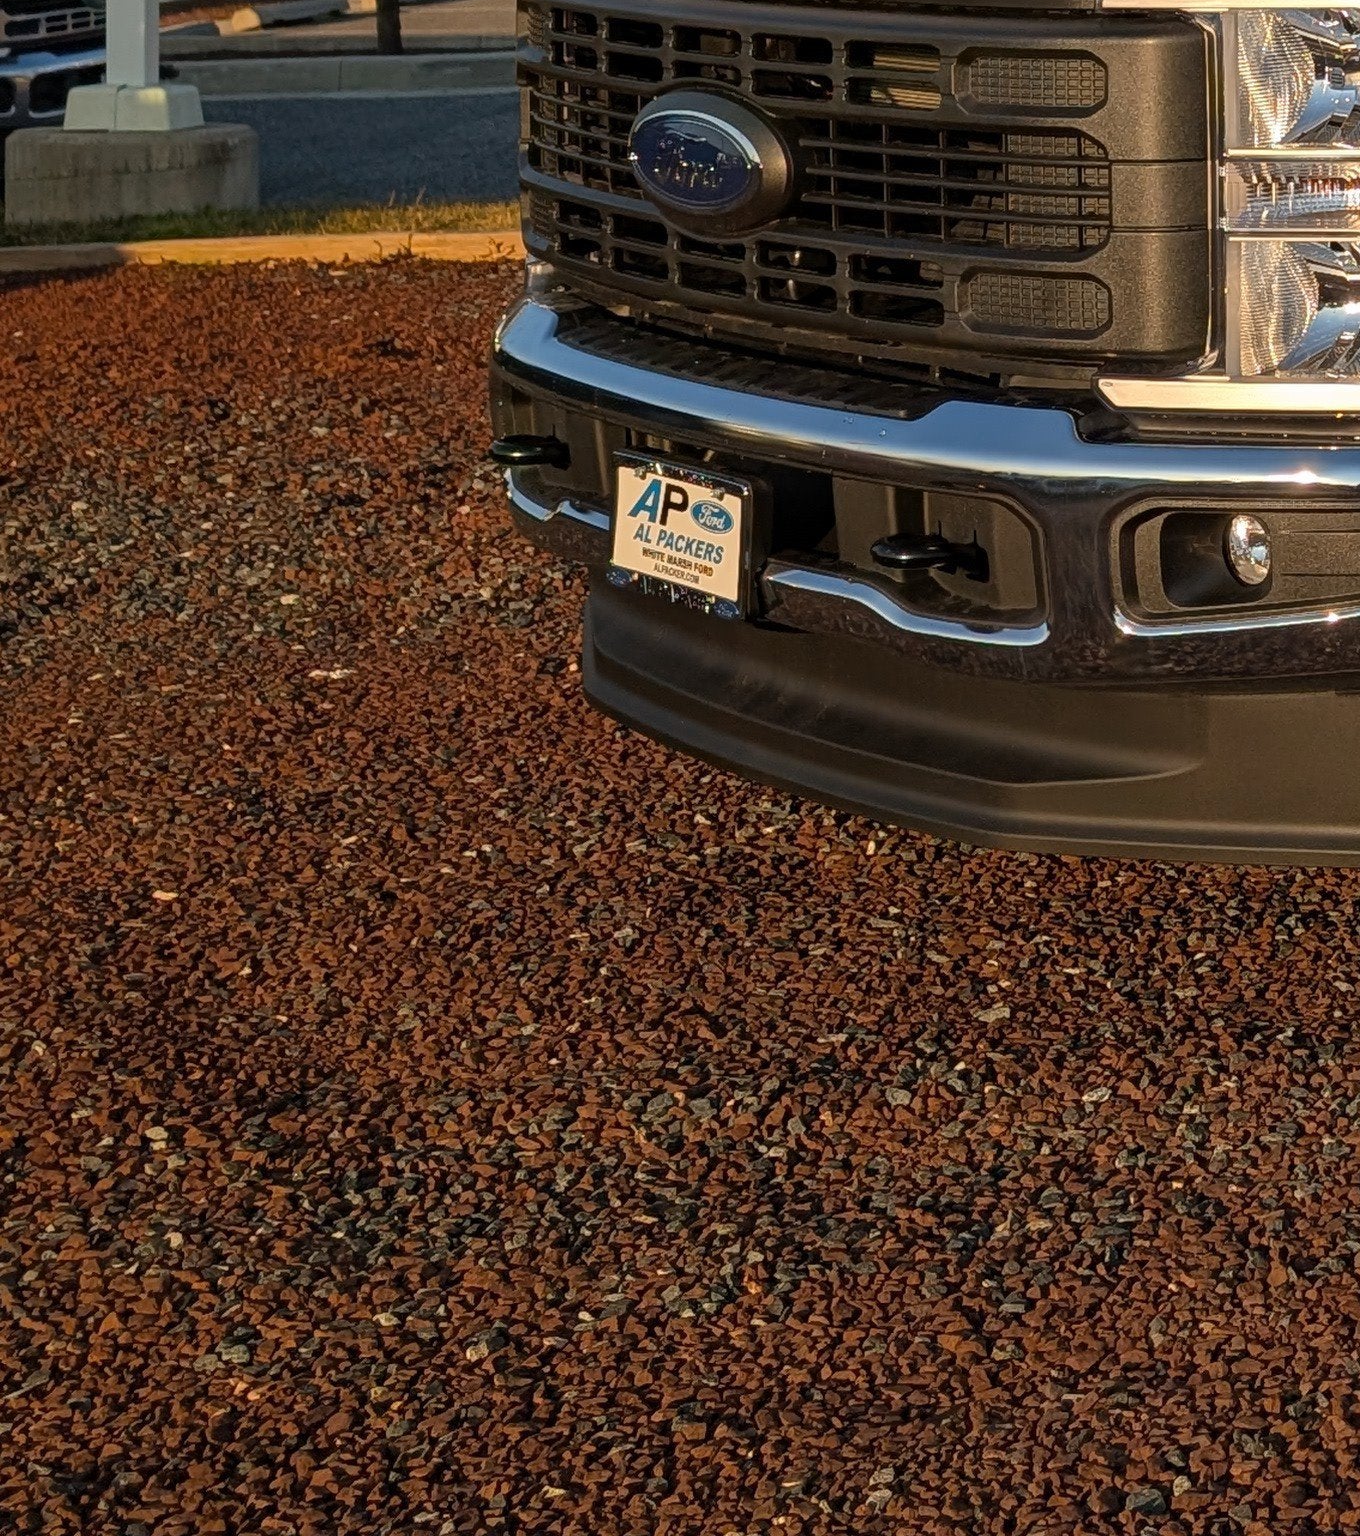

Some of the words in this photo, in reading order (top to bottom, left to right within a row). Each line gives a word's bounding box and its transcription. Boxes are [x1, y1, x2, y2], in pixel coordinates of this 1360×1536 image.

[627, 478, 689, 526] AP
[699, 503, 726, 530] Ford
[633, 523, 652, 543] AL
[656, 529, 724, 564] PACKERS
[642, 547, 665, 563] WHITE
[667, 553, 692, 570] MARSH
[694, 564, 714, 577] FORD
